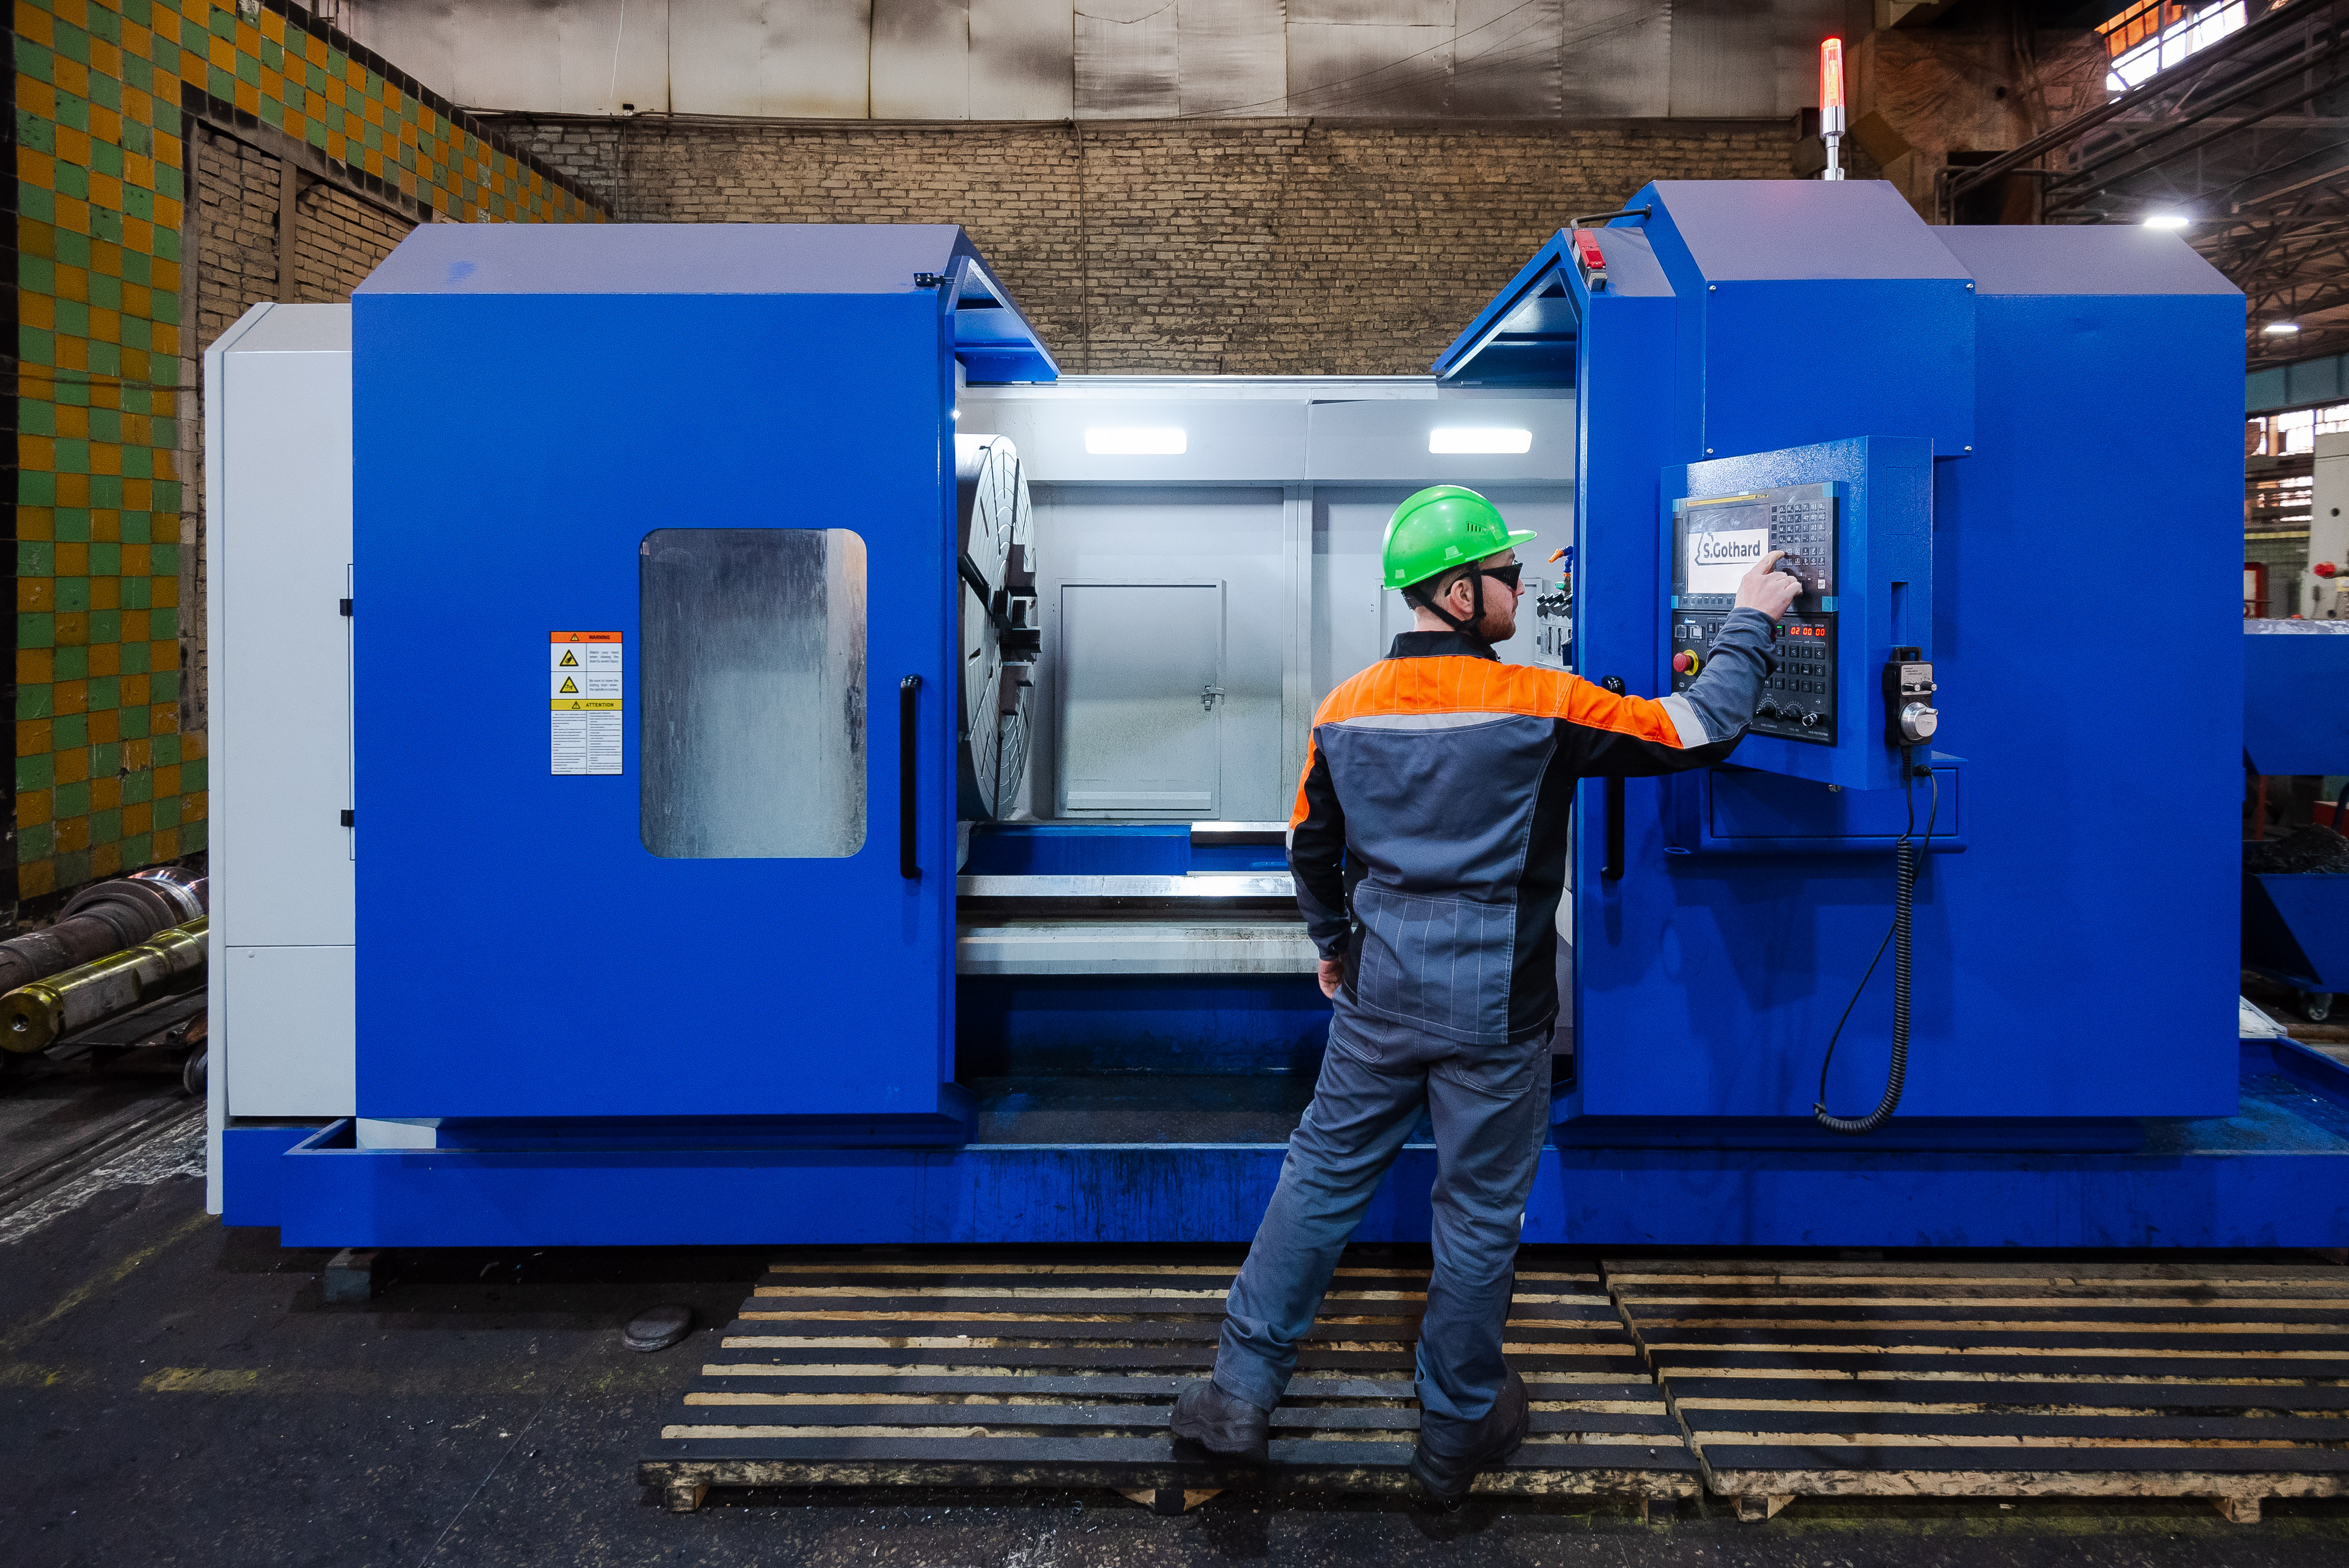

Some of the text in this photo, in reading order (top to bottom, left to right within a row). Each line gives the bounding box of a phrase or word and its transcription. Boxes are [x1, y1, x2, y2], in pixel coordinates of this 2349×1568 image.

[1704, 540, 1760, 558] S.Gothard
[1790, 627, 1825, 636] 02 00 00
